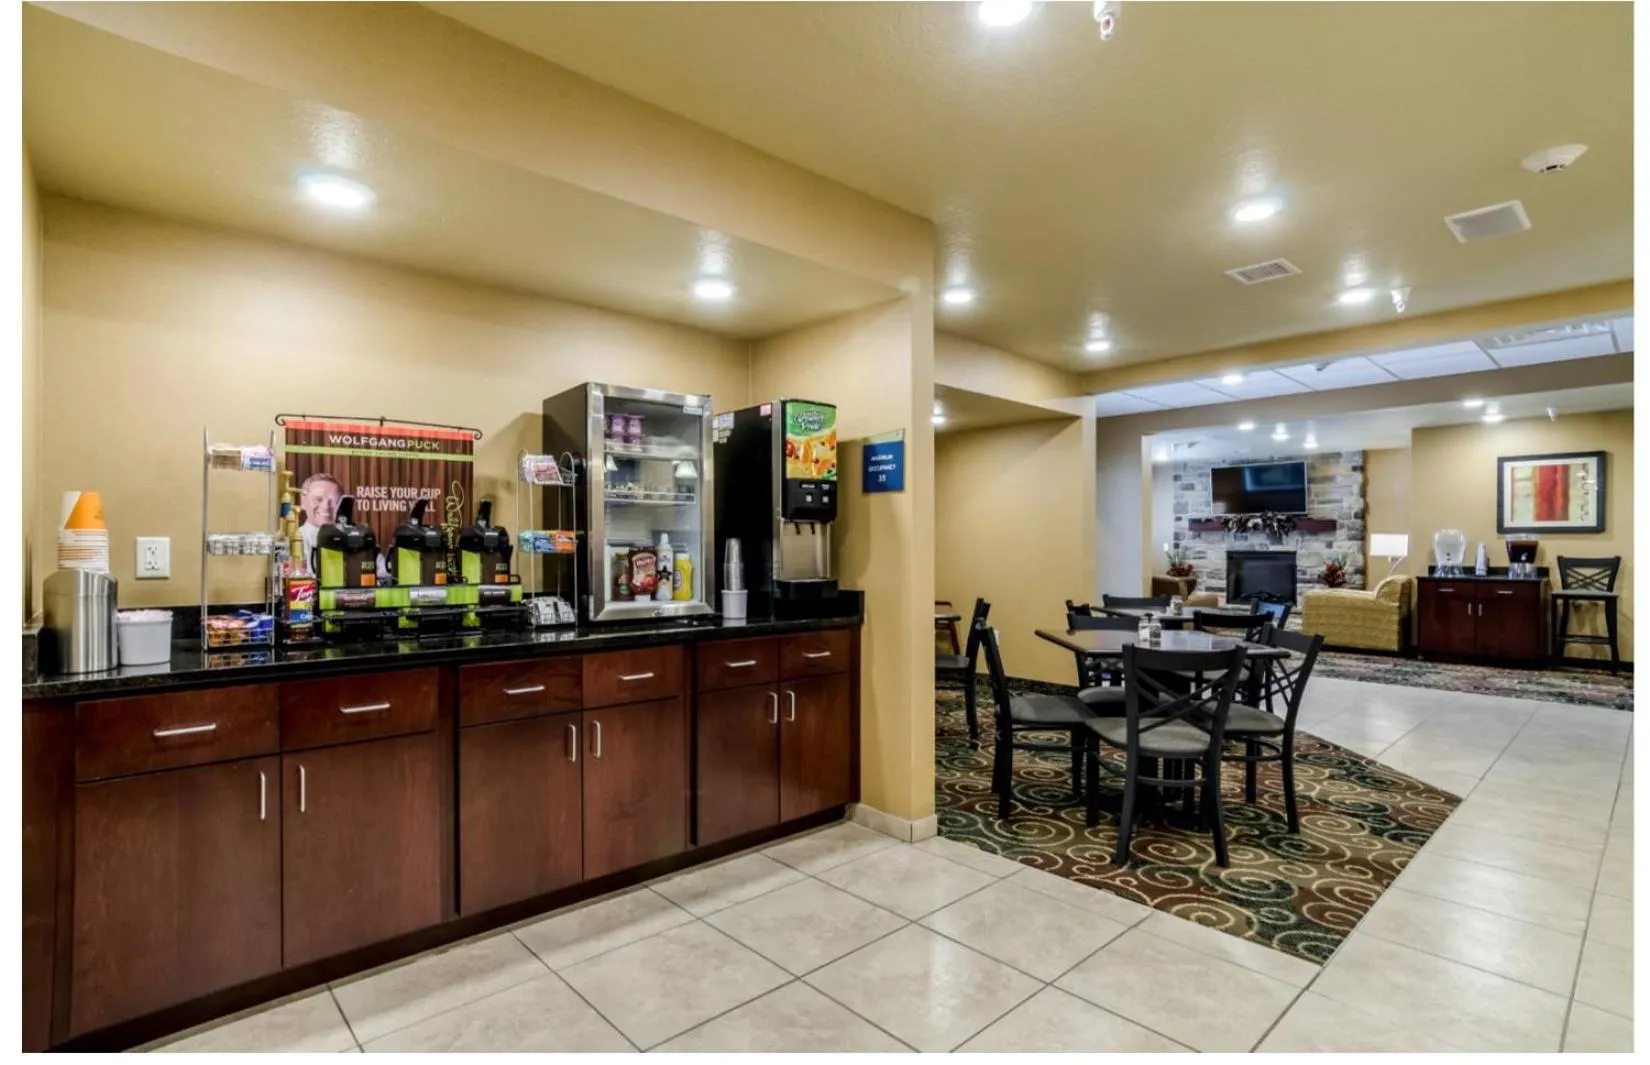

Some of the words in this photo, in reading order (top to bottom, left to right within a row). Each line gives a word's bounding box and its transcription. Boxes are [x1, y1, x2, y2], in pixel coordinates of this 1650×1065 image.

[356, 486, 388, 499] RAISE
[390, 487, 418, 499] YOUR
[420, 487, 441, 500] CUP
[356, 499, 370, 511] TO
[372, 500, 407, 512] LIVING
